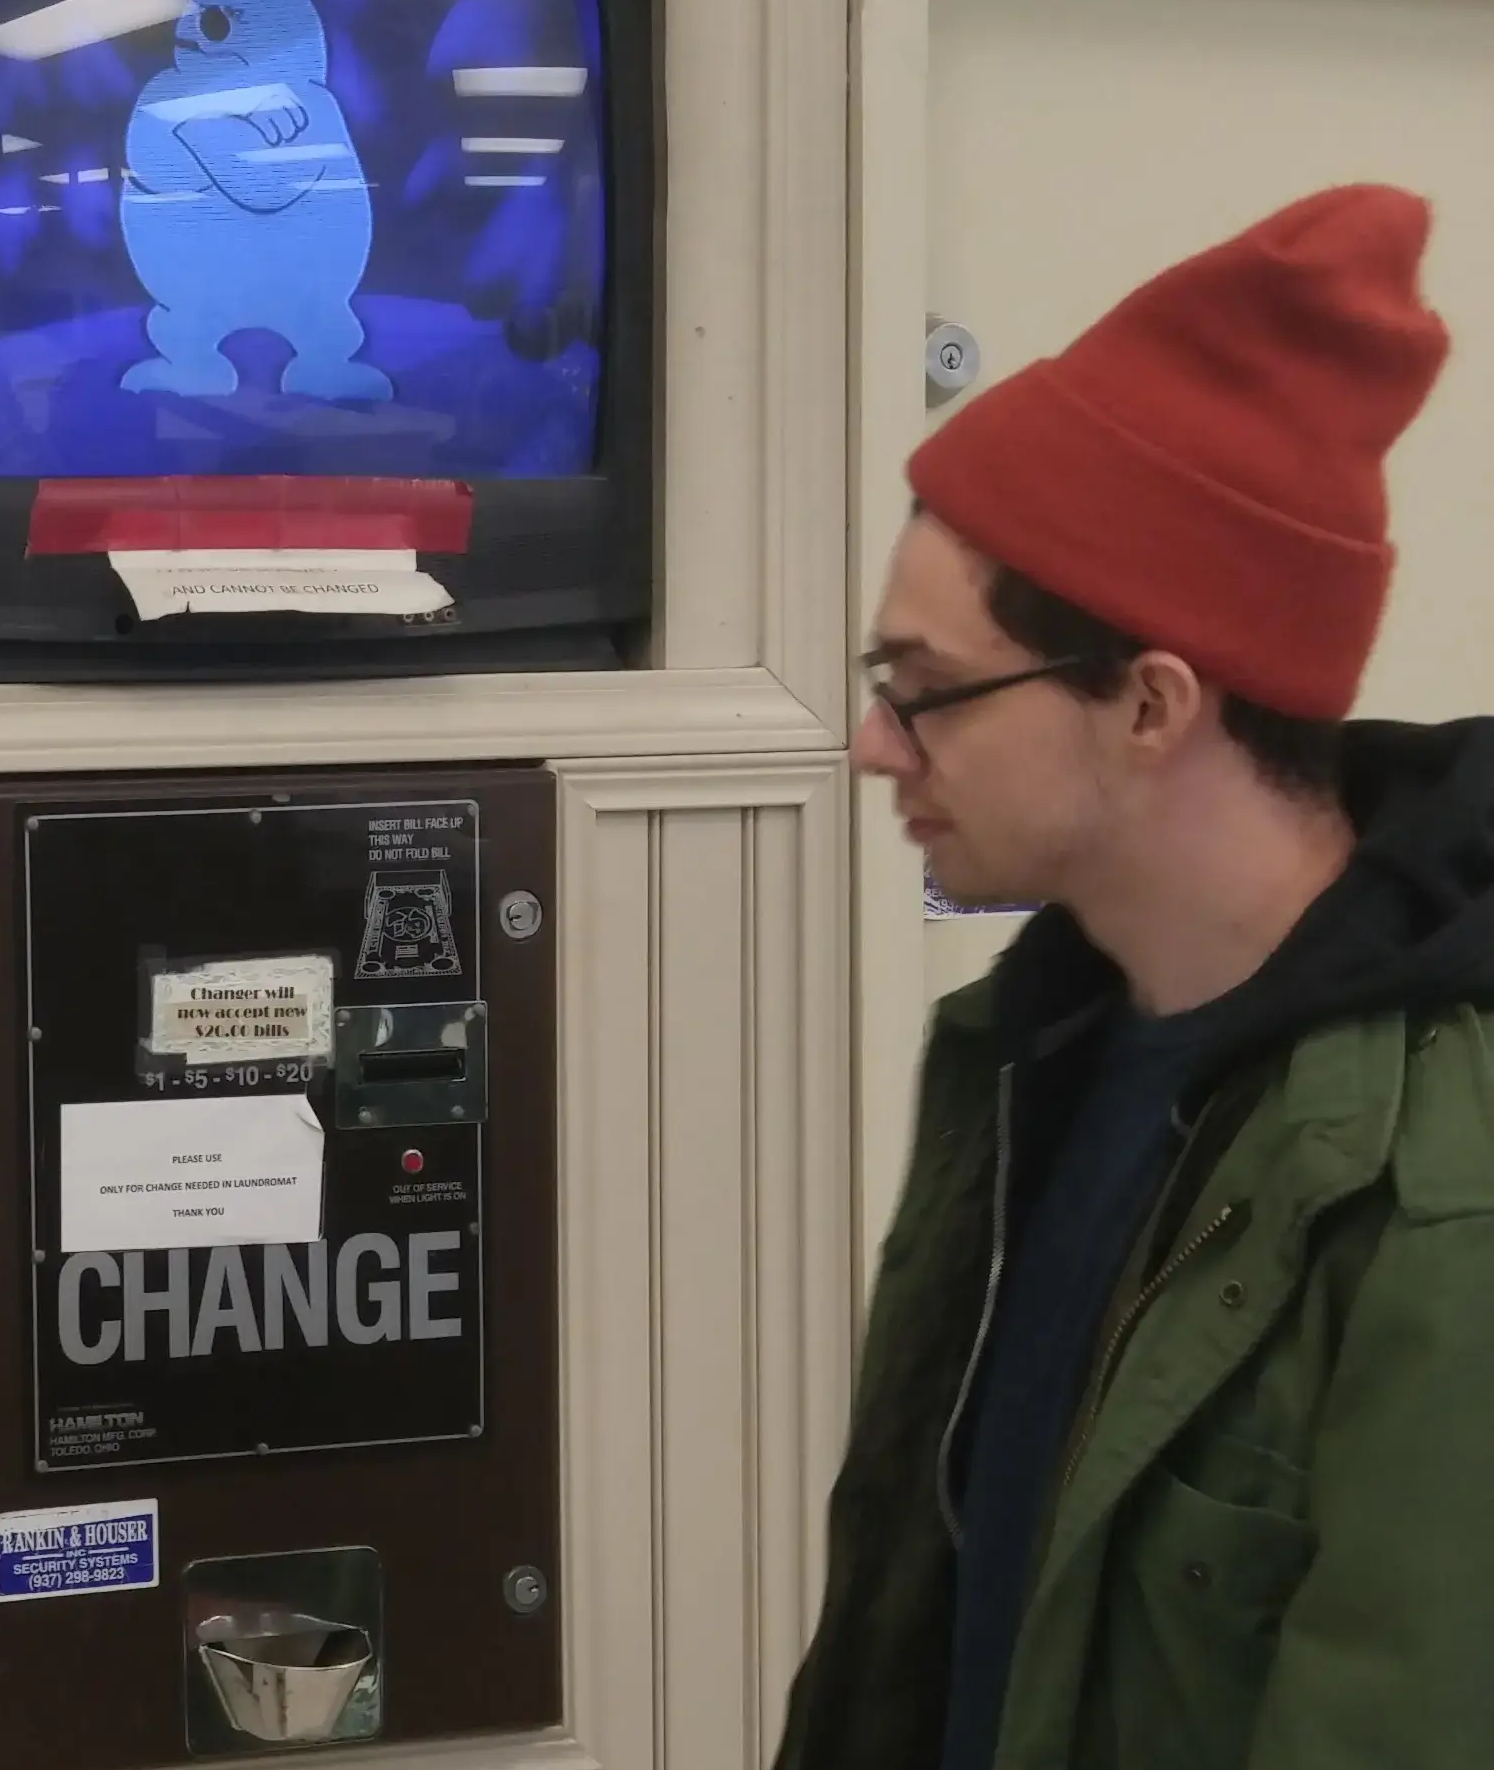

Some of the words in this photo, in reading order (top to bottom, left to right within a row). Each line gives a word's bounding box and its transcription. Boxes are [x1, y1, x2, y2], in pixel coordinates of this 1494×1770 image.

[172, 584, 205, 595] AND
[210, 584, 275, 594] CANNOT
[303, 583, 379, 594] CHANGED
[369, 819, 402, 832] INSERT
[403, 819, 424, 831] BILL
[425, 817, 449, 830] FACE
[450, 817, 464, 829] UP
[369, 834, 390, 846] THIS
[392, 833, 414, 846] WAY
[369, 848, 382, 861] DO
[384, 848, 403, 860] NOT
[405, 847, 429, 860] FOLD
[431, 846, 451, 859] BILL
[191, 987, 262, 1001] Changer
[265, 986, 294, 999] will
[178, 1007, 210, 1019] now
[215, 1004, 269, 1021] accept
[274, 1005, 307, 1018] new
[195, 1024, 250, 1037] $20.00
[254, 1023, 290, 1037] bills
[146, 1071, 165, 1091] $1
[185, 1070, 208, 1089] $5
[226, 1066, 259, 1086] $10
[277, 1063, 313, 1083] $20
[172, 1155, 203, 1164] PLEASE
[205, 1154, 222, 1163] USE
[100, 1185, 123, 1195] ONLY
[125, 1184, 144, 1193] FOR
[145, 1182, 183, 1193] CHANGE
[185, 1180, 220, 1191] NEEDED
[222, 1180, 232, 1189] IN
[234, 1177, 298, 1188] LAUNDROMAT
[392, 1185, 412, 1194] OUT
[413, 1184, 425, 1193] OF
[425, 1181, 463, 1191] SERVICE
[389, 1194, 415, 1204] WHEN
[416, 1192, 443, 1203] LIGHT
[443, 1192, 452, 1200] IS
[453, 1191, 467, 1200] ON
[172, 1208, 204, 1218] THANK
[205, 1207, 225, 1217] YOU
[58, 1230, 463, 1365] CHANGE
[50, 1432, 101, 1445] HAMILTON
[2, 1527, 65, 1555] RANKIN
[70, 1525, 82, 1548] &
[85, 1520, 148, 1546] HOUSER
[66, 1548, 86, 1558] INC
[14, 1559, 76, 1575] SECURITY
[79, 1552, 139, 1569] SYSTEMS
[29, 1574, 62, 1591] (937)
[65, 1567, 125, 1585] 298-9823
